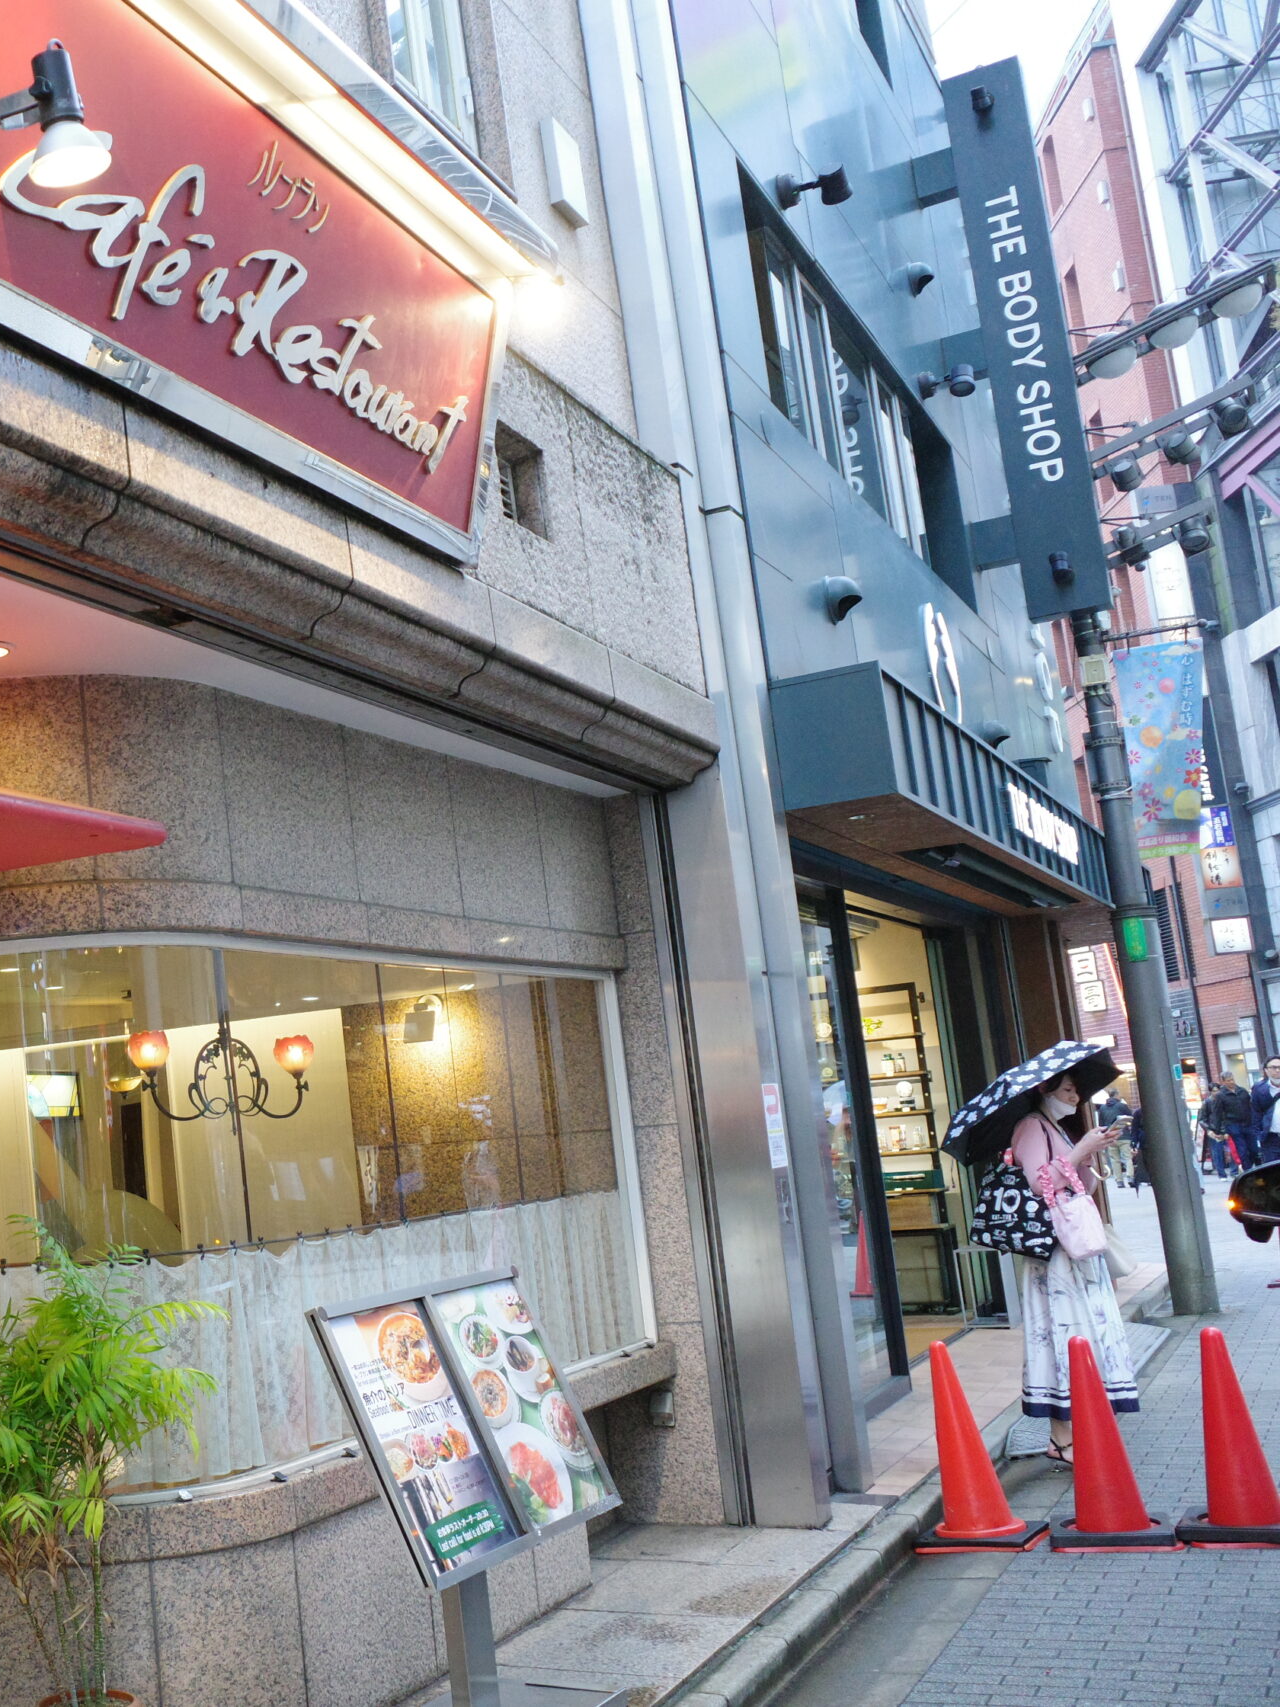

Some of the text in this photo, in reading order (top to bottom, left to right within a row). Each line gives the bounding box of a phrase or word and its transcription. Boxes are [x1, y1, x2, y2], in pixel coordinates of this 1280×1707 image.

[231, 249, 470, 475] Restaurant
[984, 185, 1066, 483] THE BODY SHOP
[406, 1397, 458, 1430] DINNER TIME
